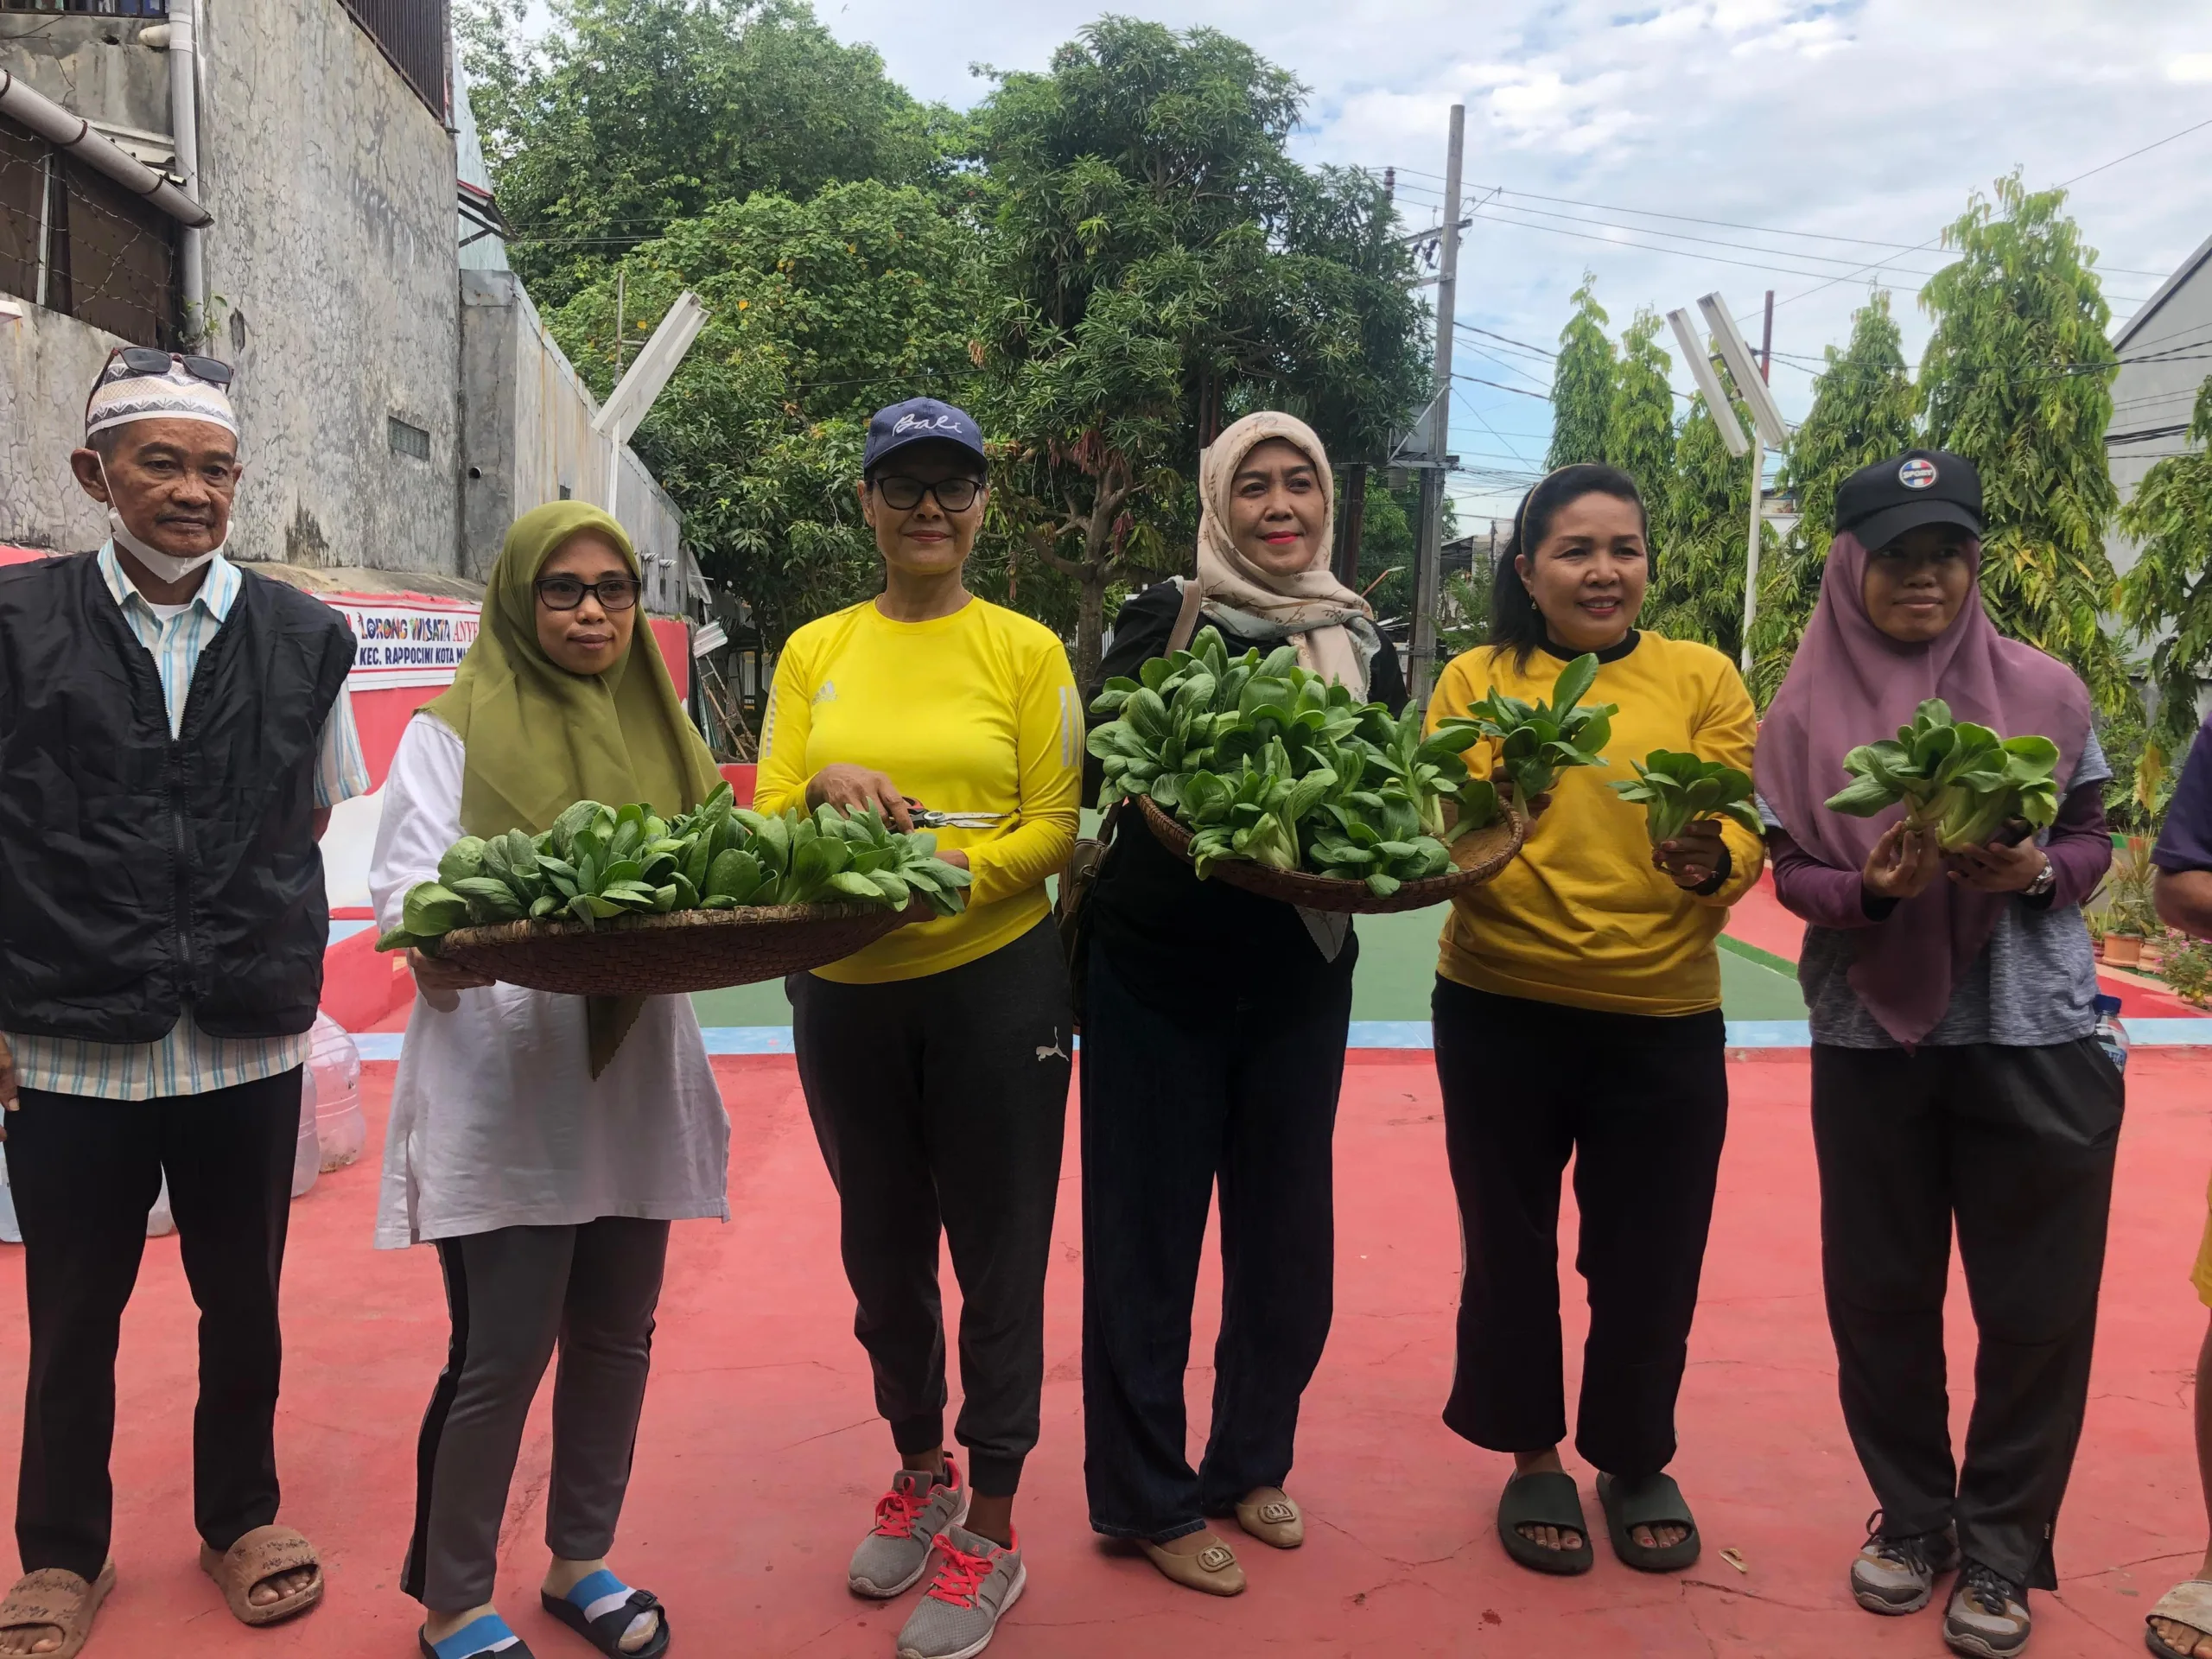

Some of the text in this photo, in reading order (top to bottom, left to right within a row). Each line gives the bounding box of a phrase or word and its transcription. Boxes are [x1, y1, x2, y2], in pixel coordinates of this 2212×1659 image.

[892, 413, 963, 437] Bali
[357, 612, 408, 640] LORONG
[409, 616, 451, 642] WISATA
[359, 647, 382, 666] KEC.
[385, 646, 434, 664] RAPPOCINI
[435, 647, 454, 664] KOTA
